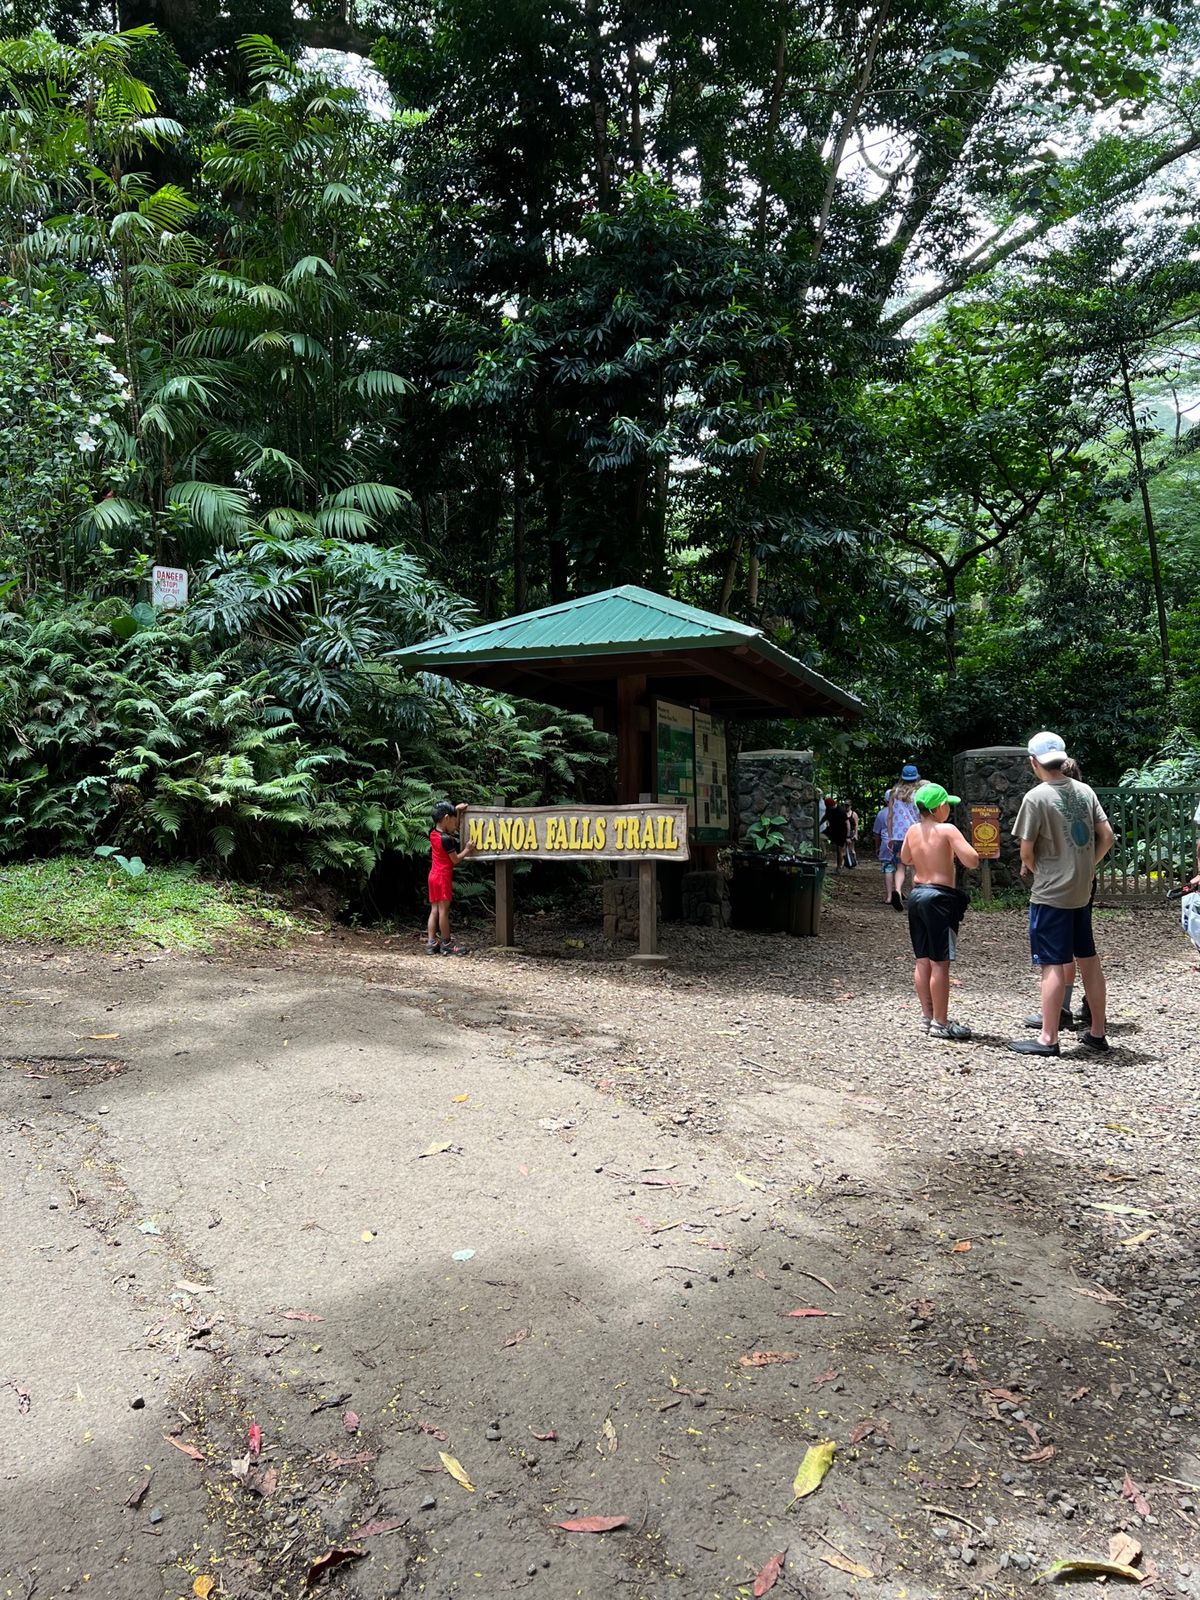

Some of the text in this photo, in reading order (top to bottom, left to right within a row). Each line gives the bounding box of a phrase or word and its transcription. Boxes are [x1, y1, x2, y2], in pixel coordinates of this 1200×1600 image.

[157, 570, 184, 582] DANGER
[469, 815, 679, 851] MANOA FALLS TRAIL
